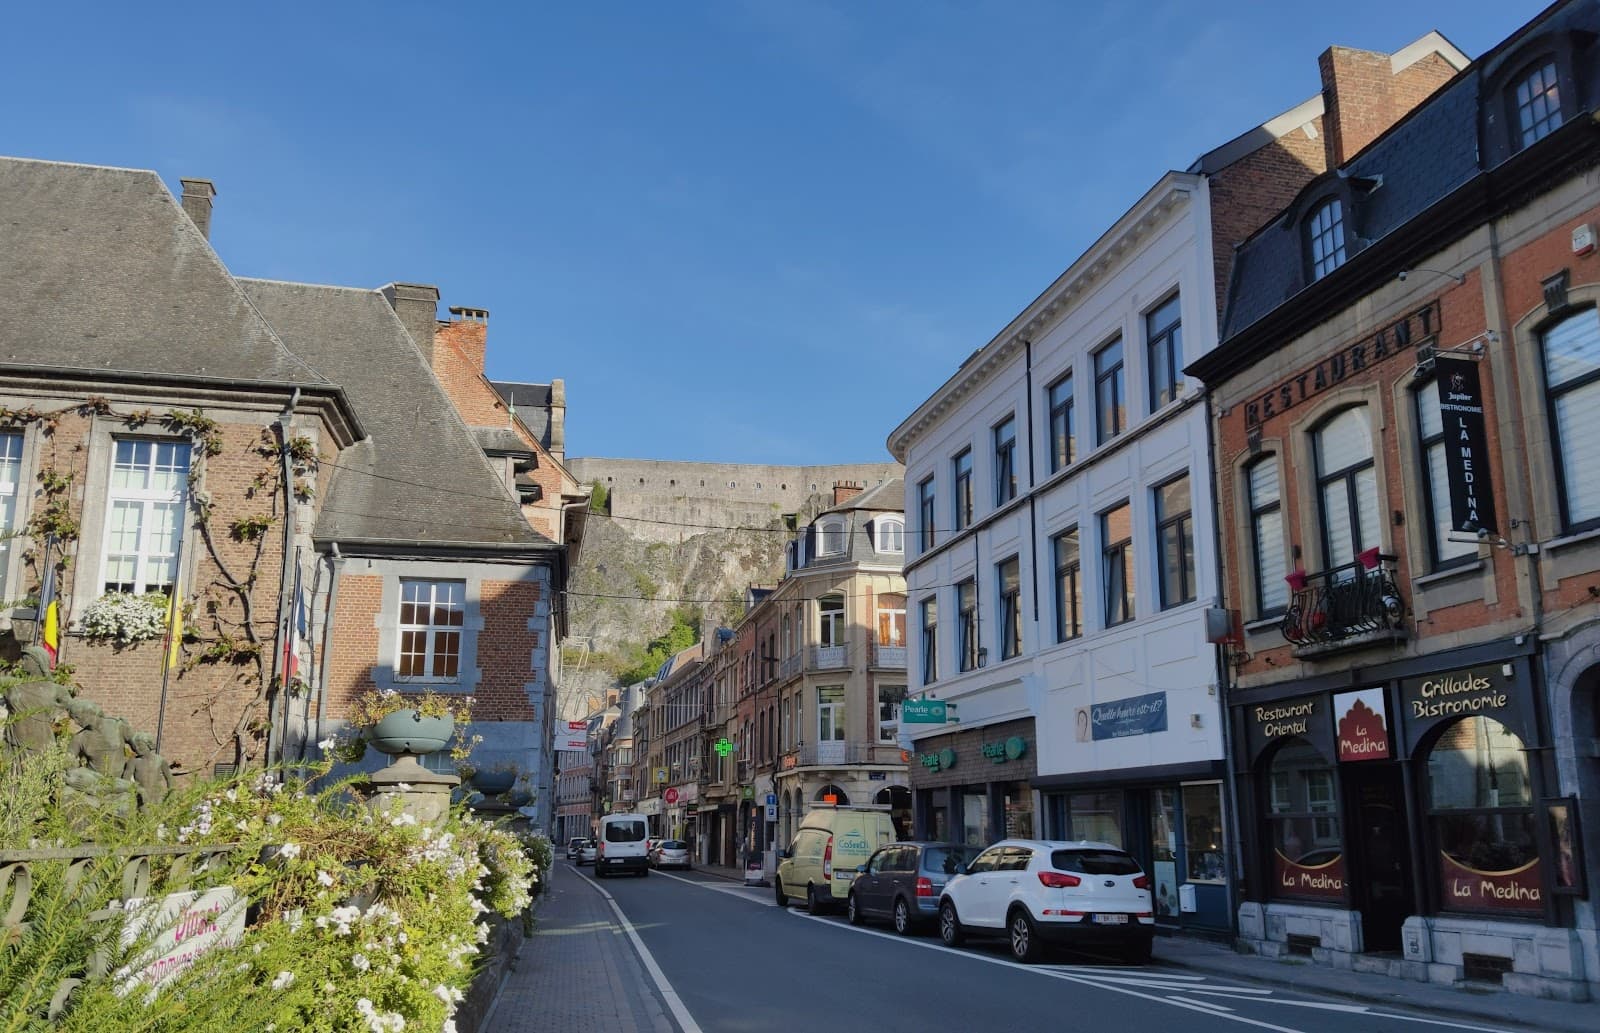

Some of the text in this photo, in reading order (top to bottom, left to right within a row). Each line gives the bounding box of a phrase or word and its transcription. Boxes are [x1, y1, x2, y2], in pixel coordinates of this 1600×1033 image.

[1247, 307, 1431, 425] RESTAURANT
[1448, 392, 1472, 401] Jupiler
[1440, 403, 1482, 413] BISTRONOMIE
[1459, 416, 1478, 521] LA MEDINA
[1421, 673, 1490, 698] Grillades
[905, 704, 928, 713] Pearle
[1256, 702, 1313, 722] Restaurant
[1412, 690, 1506, 718] Bistronomie
[1264, 719, 1306, 736] Oriental
[1357, 724, 1367, 736] La
[982, 742, 1005, 757] Pearle
[1341, 738, 1385, 754] Medina
[921, 752, 939, 767] Pearle
[1283, 872, 1342, 889] La Medina
[1453, 878, 1540, 900] La Medina
